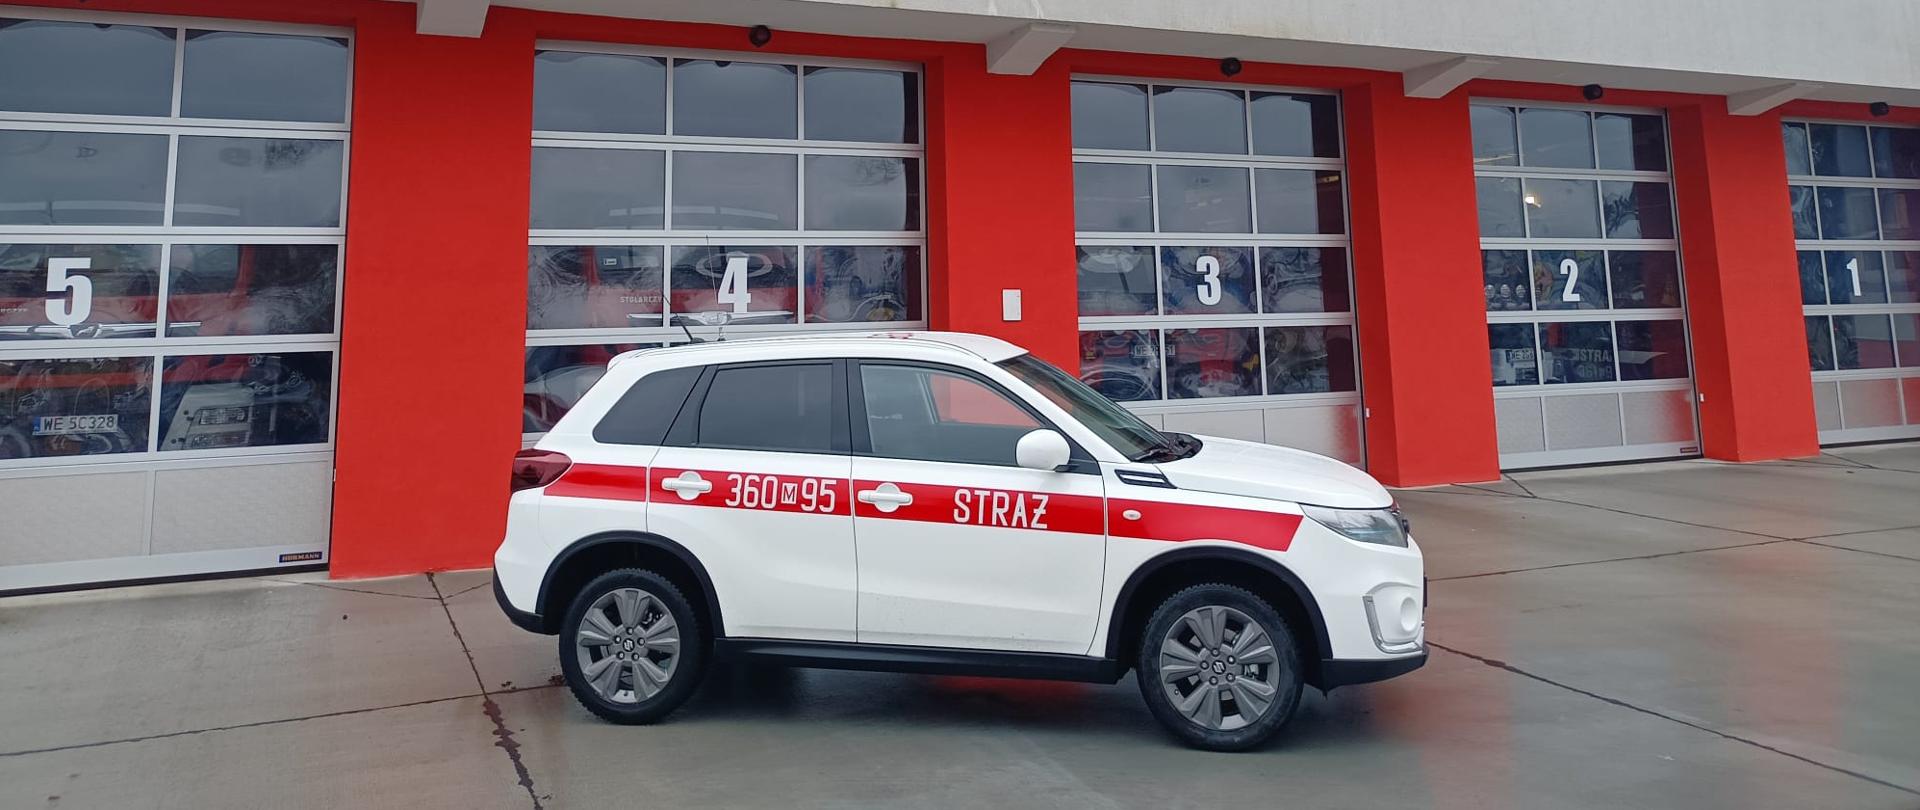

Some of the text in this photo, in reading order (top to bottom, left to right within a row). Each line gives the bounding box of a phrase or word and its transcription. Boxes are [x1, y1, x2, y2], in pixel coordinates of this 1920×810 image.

[45, 257, 92, 326] 5
[717, 256, 752, 313] 4
[1196, 255, 1222, 306] 3
[1559, 258, 1581, 302] 2
[1846, 257, 1862, 297] 1
[43, 417, 63, 431] WE
[69, 415, 115, 430] 5C328
